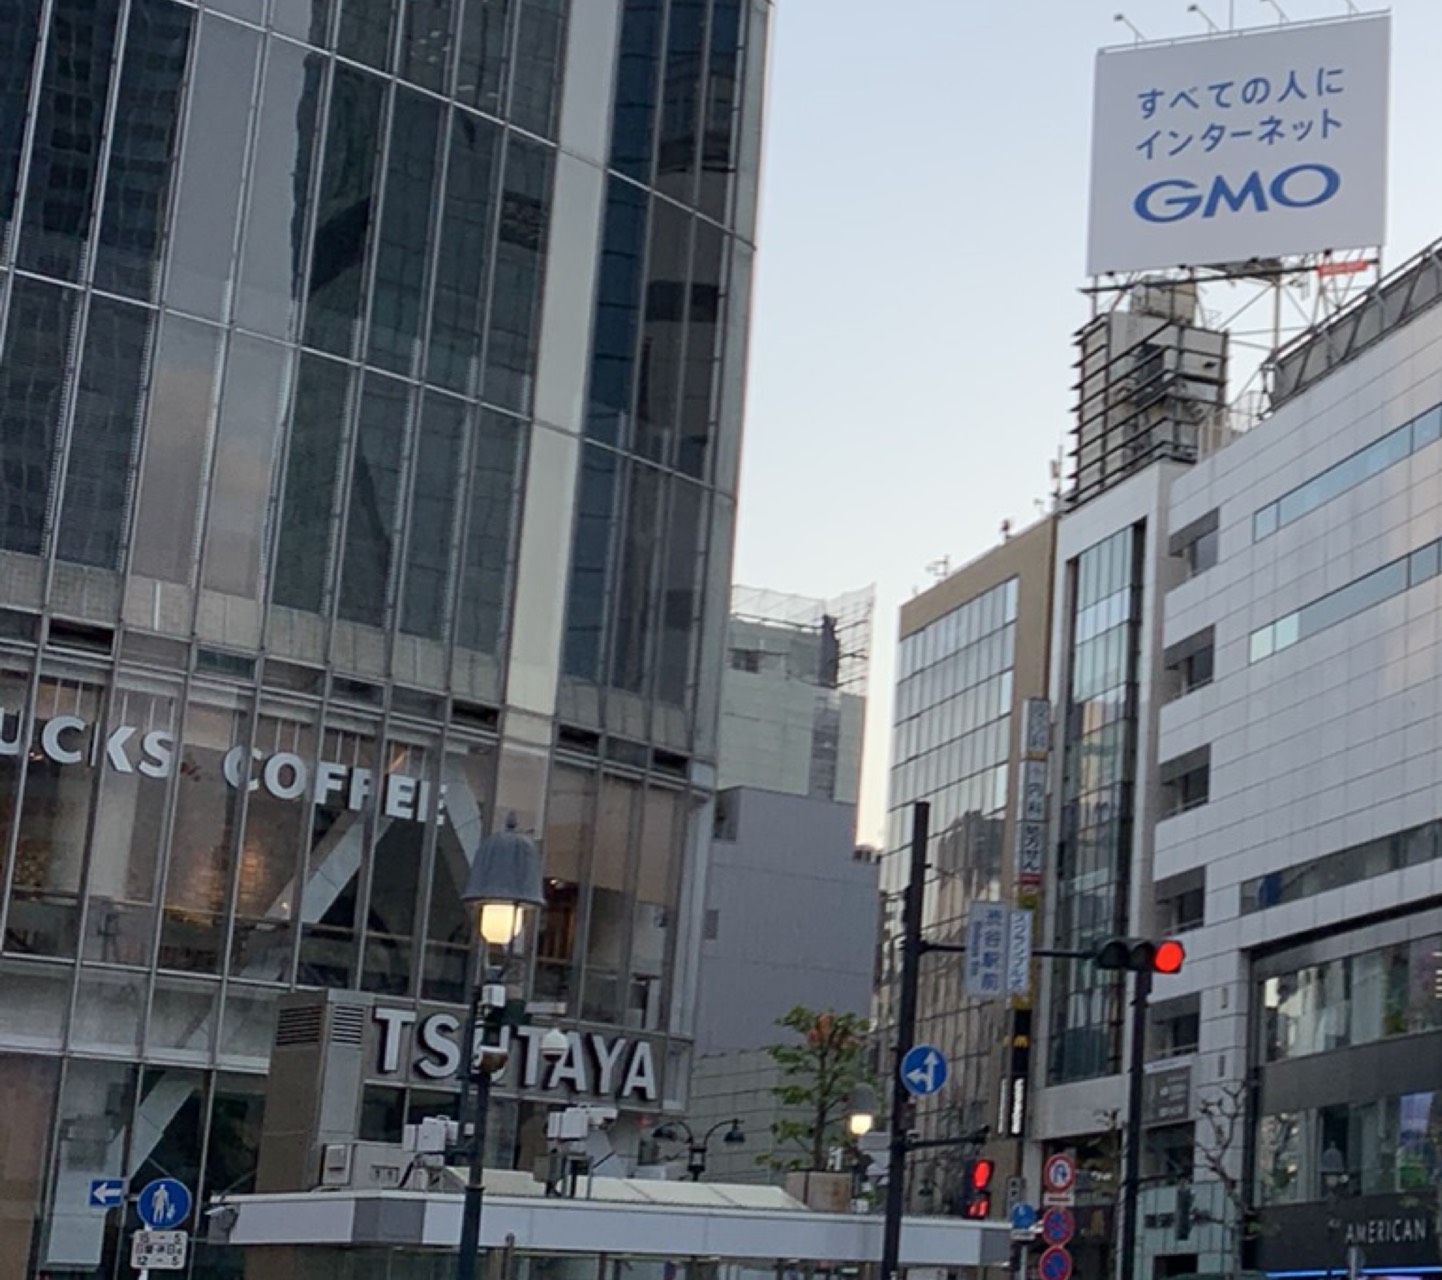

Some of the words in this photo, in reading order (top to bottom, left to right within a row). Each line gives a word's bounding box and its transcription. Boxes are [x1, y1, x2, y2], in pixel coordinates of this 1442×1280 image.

[1136, 67, 1345, 119] すべての人に
[1135, 108, 1343, 160] インターネット
[1133, 162, 1342, 223] GMO
[222, 745, 449, 826] COFFEE
[1345, 1217, 1427, 1245] AMERICAN
